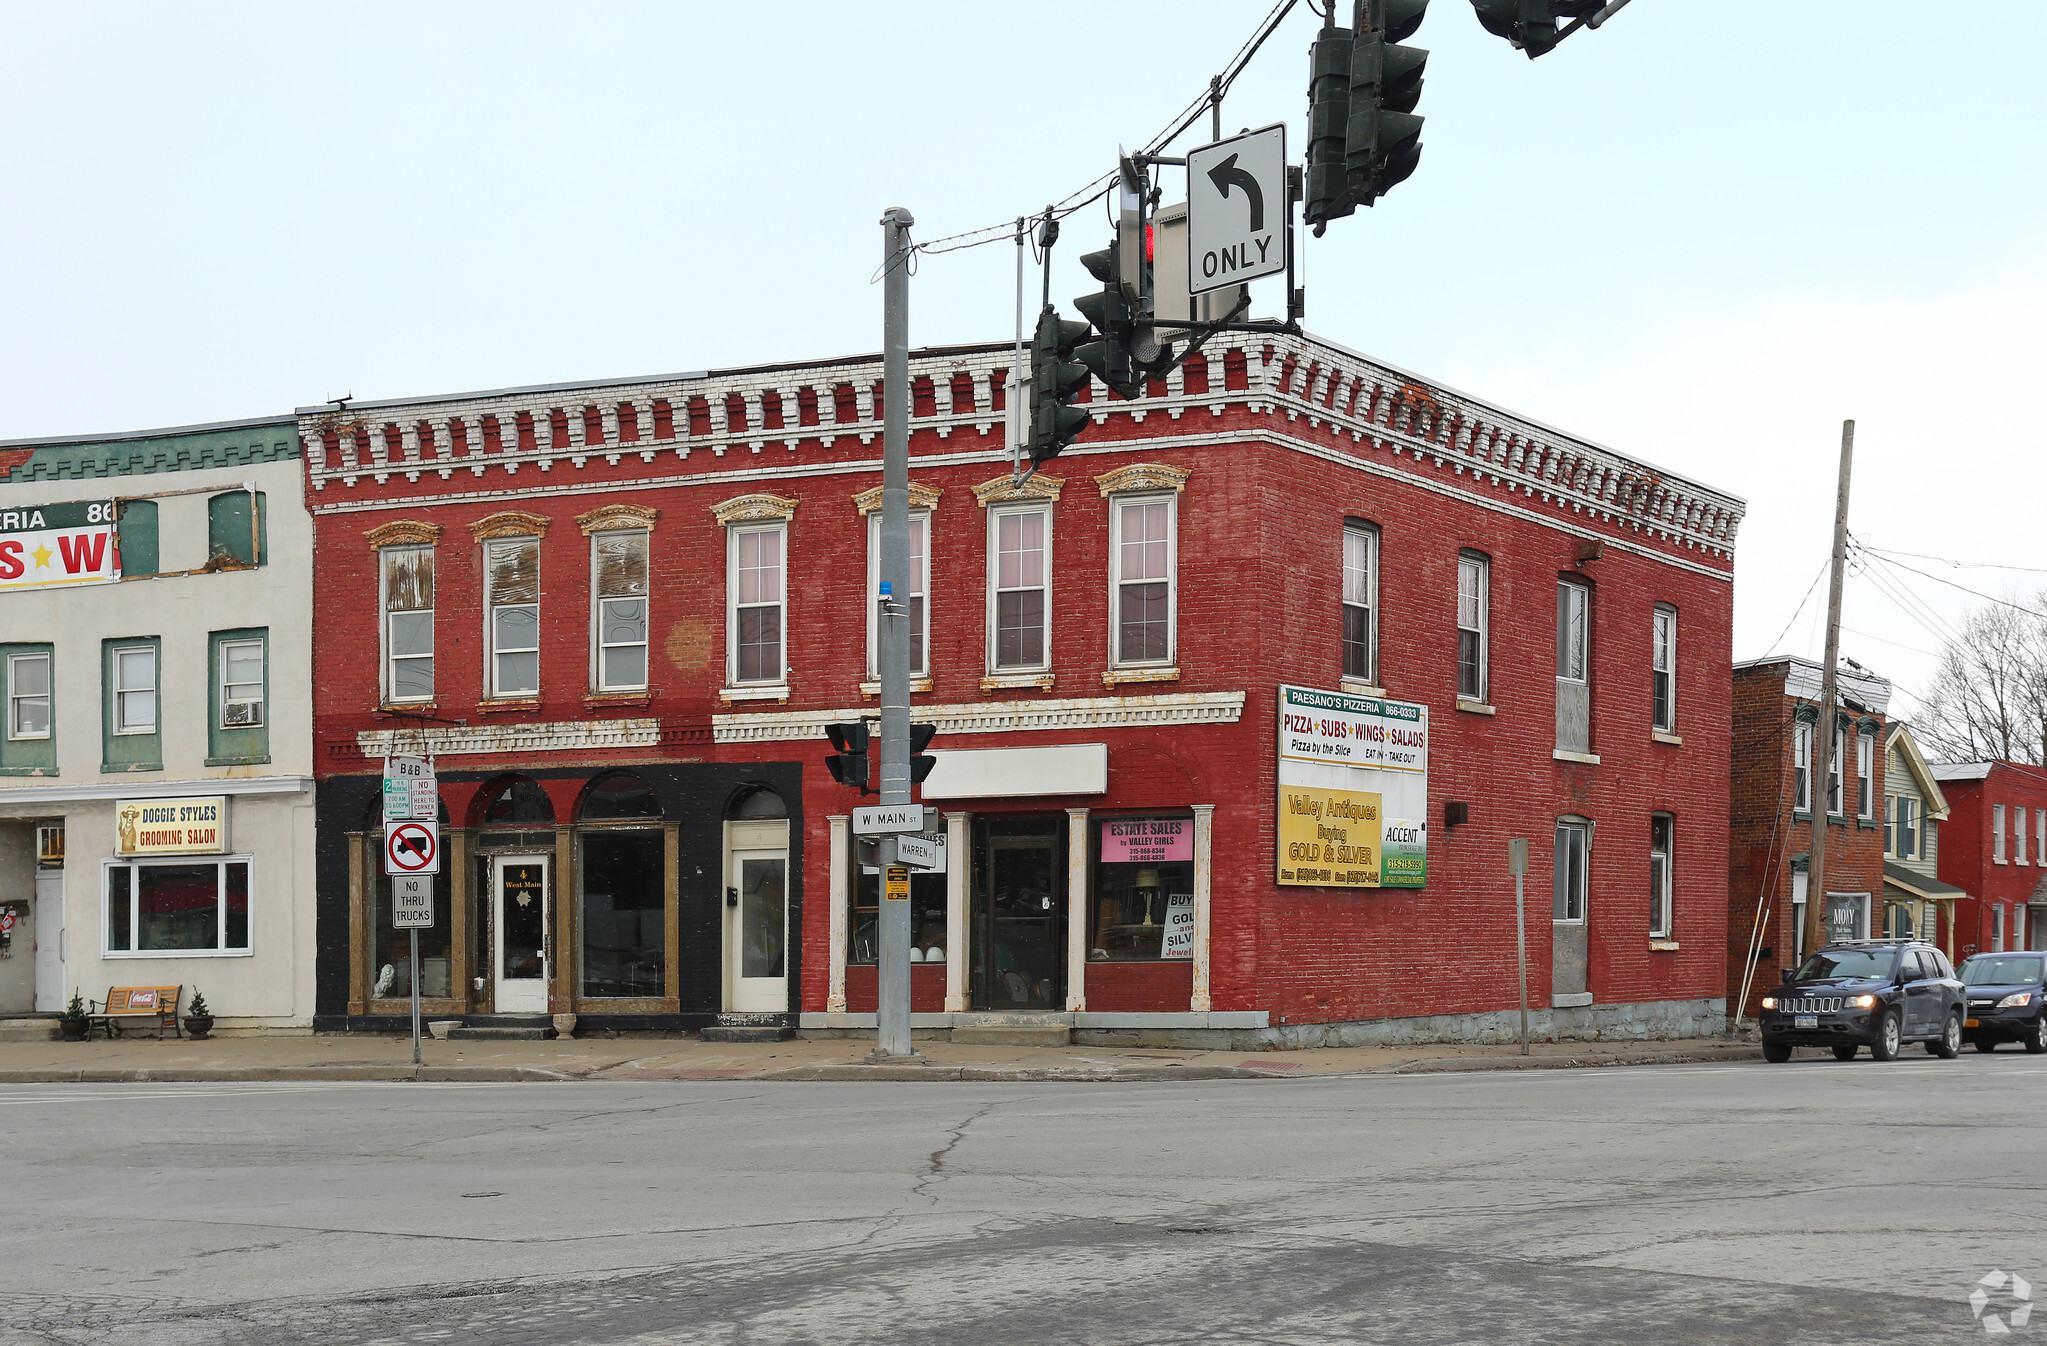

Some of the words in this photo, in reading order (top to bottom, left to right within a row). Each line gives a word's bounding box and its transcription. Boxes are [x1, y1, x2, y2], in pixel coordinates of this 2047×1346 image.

[1202, 235, 1273, 278] ONLY
[0, 510, 46, 530] RIA
[0, 541, 25, 579] S
[57, 533, 107, 574] W
[1292, 692, 1342, 708] PAESANO'S
[1343, 699, 1380, 713] PIZZERIA
[1385, 705, 1417, 719] 866-0333
[1284, 714, 1313, 734] PIZZA
[1321, 719, 1347, 738] SUBS
[1355, 722, 1385, 743] WINGS
[1391, 728, 1424, 748] SALADS
[1291, 739, 1311, 752] Pizza
[1312, 742, 1321, 755] by
[1322, 743, 1334, 755] the
[1334, 744, 1351, 757] Slice
[1365, 748, 1376, 759] EAT
[1377, 750, 1384, 760] IN
[1389, 751, 1403, 763] TAKE
[1403, 753, 1416, 764] OUT
[400, 763, 421, 776] B&B
[385, 781, 392, 792] 2
[418, 781, 429, 789] NO
[143, 807, 176, 823] DOGGIE
[180, 805, 217, 822] STYLES
[1288, 794, 1324, 821] Valley
[1326, 798, 1377, 824] Antiques
[862, 815, 871, 825] W
[878, 813, 906, 825] MAIN
[140, 830, 182, 846] GROOMING
[187, 828, 216, 844] SALON
[1111, 823, 1148, 836] ESTATE
[1150, 822, 1182, 835] SALES
[1317, 824, 1347, 844] Buying
[1385, 827, 1418, 843] ACCENT
[1129, 837, 1153, 846] VALLEY
[1154, 836, 1175, 845] GIRLS
[901, 843, 928, 858] WARREN
[1289, 842, 1320, 861] GOLD
[1323, 844, 1335, 863] &
[1337, 845, 1373, 865] SILVER
[519, 869, 528, 879] 4
[405, 881, 418, 892] NO
[400, 896, 424, 906] THRU
[396, 910, 430, 921] TRUCKS
